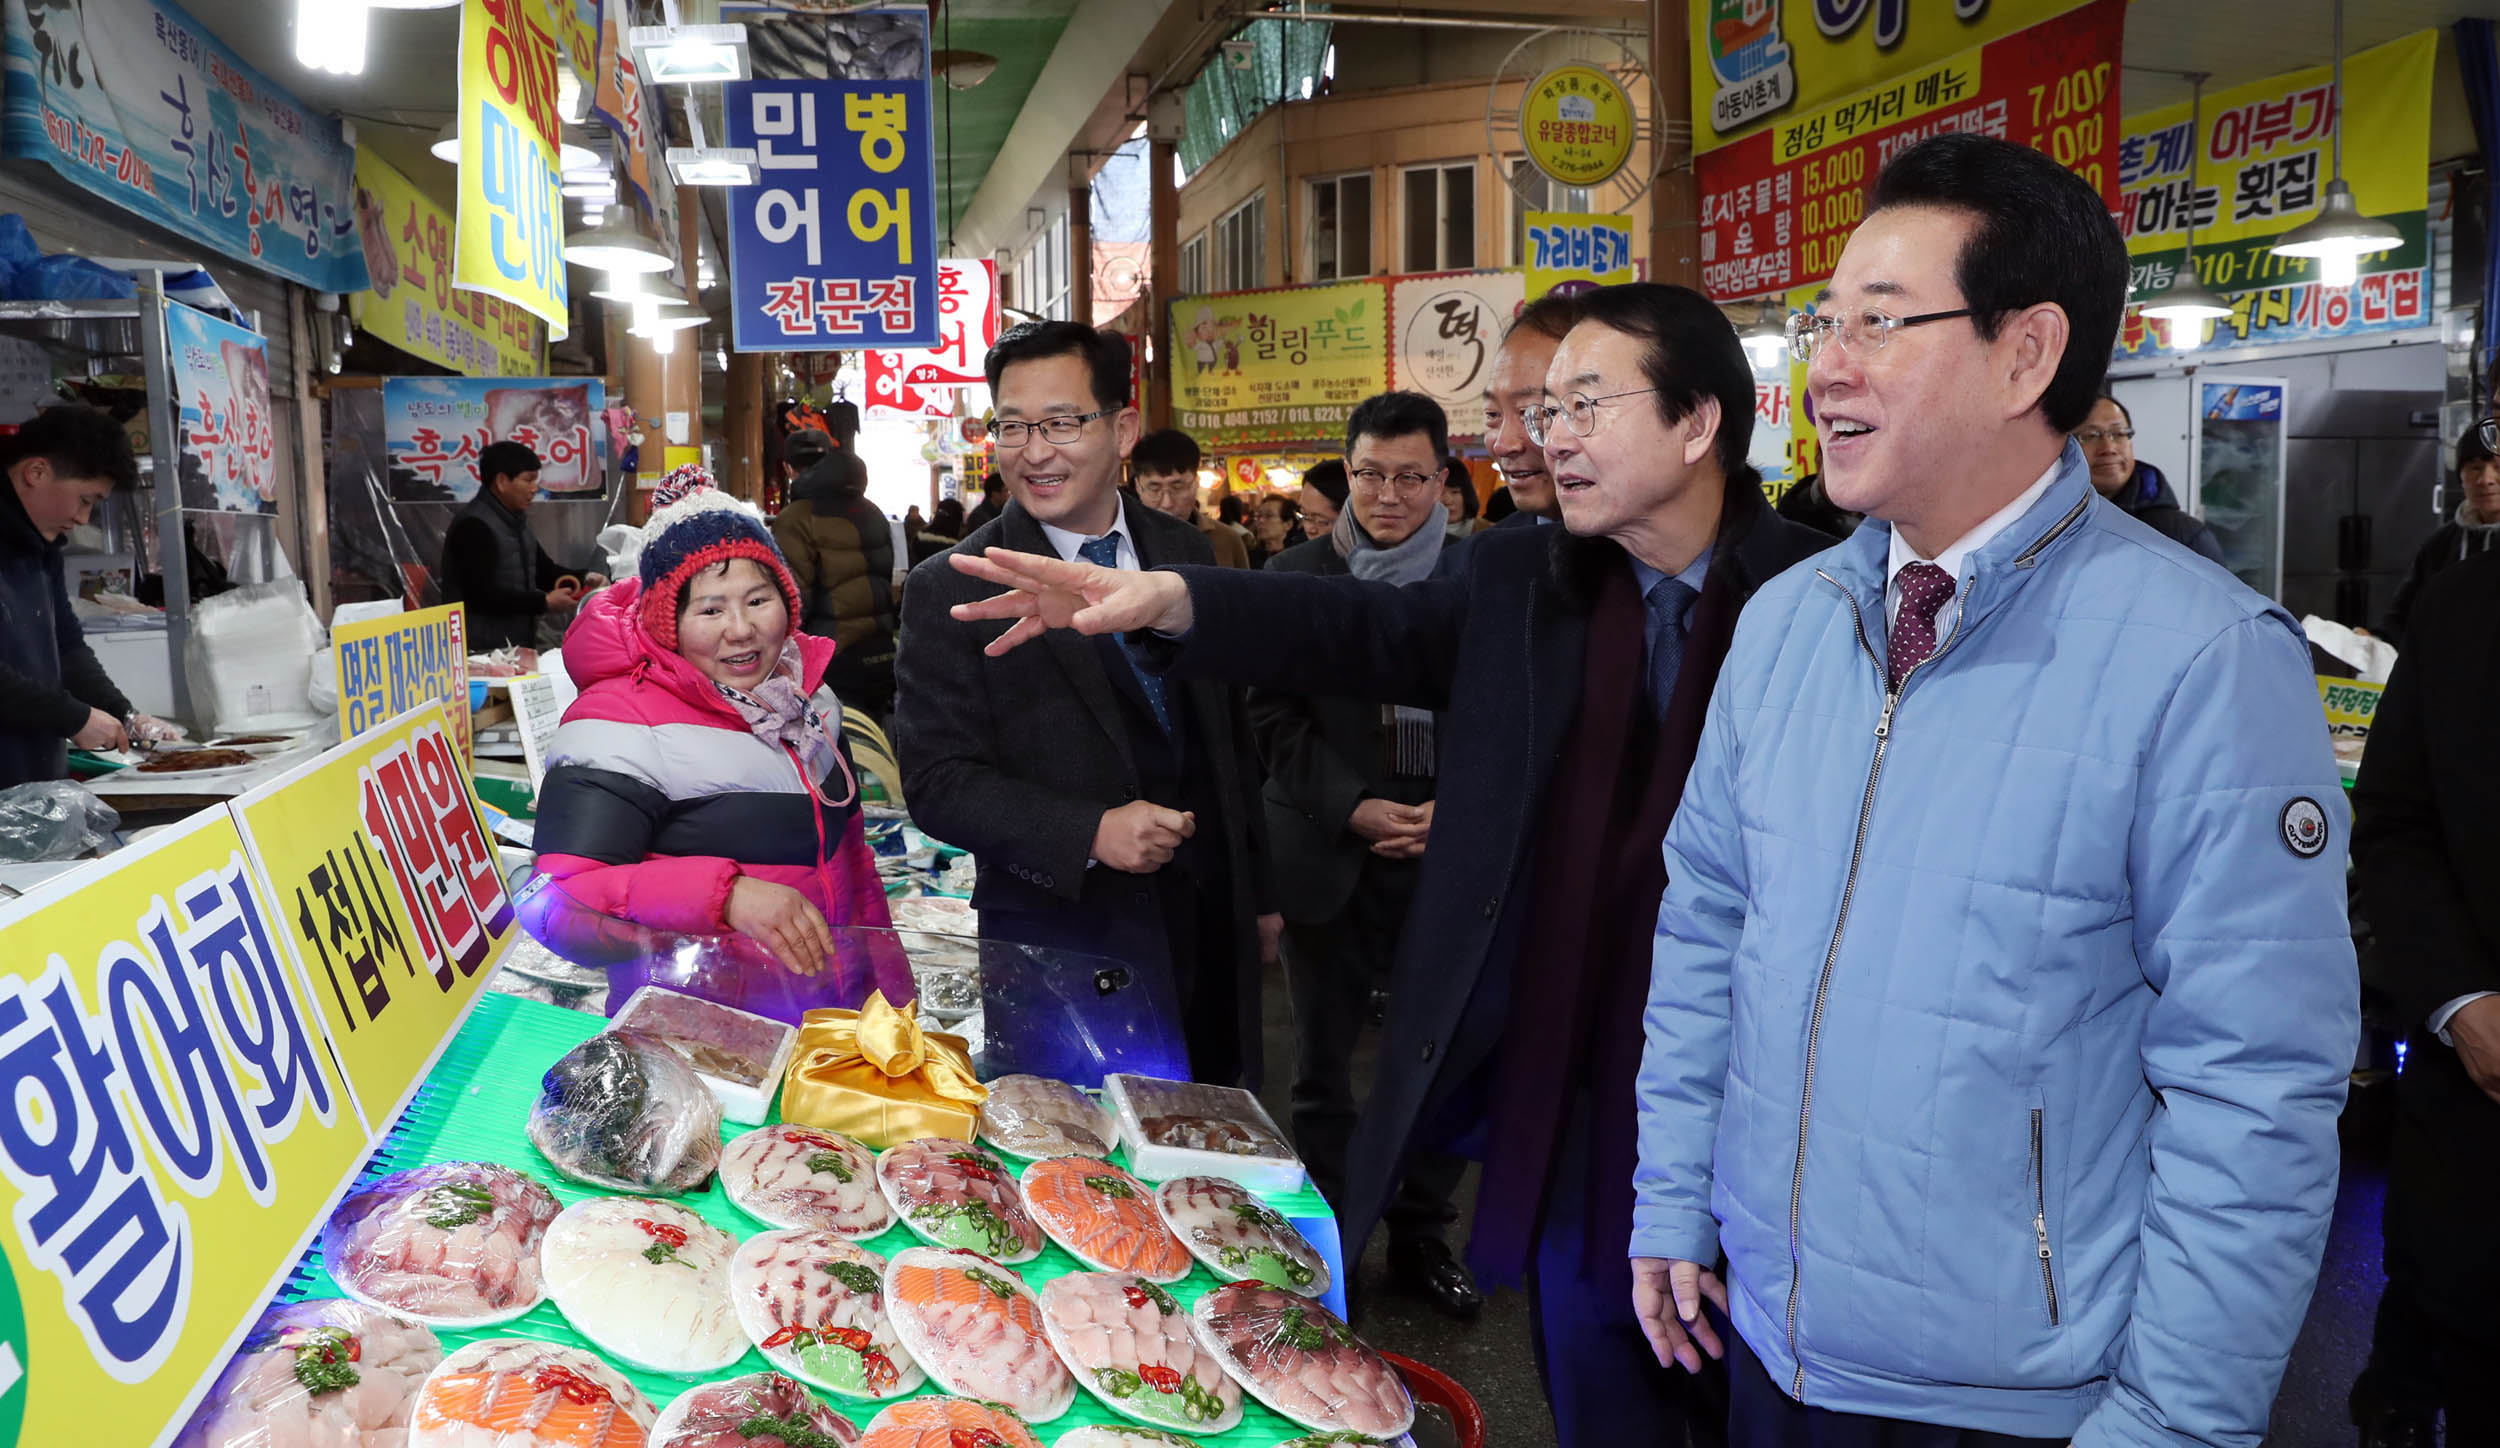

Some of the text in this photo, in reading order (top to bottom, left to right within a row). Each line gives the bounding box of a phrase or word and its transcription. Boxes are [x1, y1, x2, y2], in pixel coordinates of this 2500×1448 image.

[1717, 73, 1781, 122] 마동어촌계
[1784, 68, 1967, 157] 점심 먹거리 메뉴
[2027, 61, 2112, 127] 7,000
[1538, 120, 1617, 147] 유달종합코너
[1801, 146, 1865, 197] 15,000
[2235, 151, 2318, 221] 횟집
[1800, 182, 1864, 236] 10,000
[1528, 225, 1629, 274] 가리비조개
[763, 277, 916, 334] 전문점
[1434, 299, 1485, 393] 떡
[407, 401, 451, 418] 남도의
[298, 728, 505, 1033] 1접시 1만원
[0, 865, 330, 1363] 활어회
